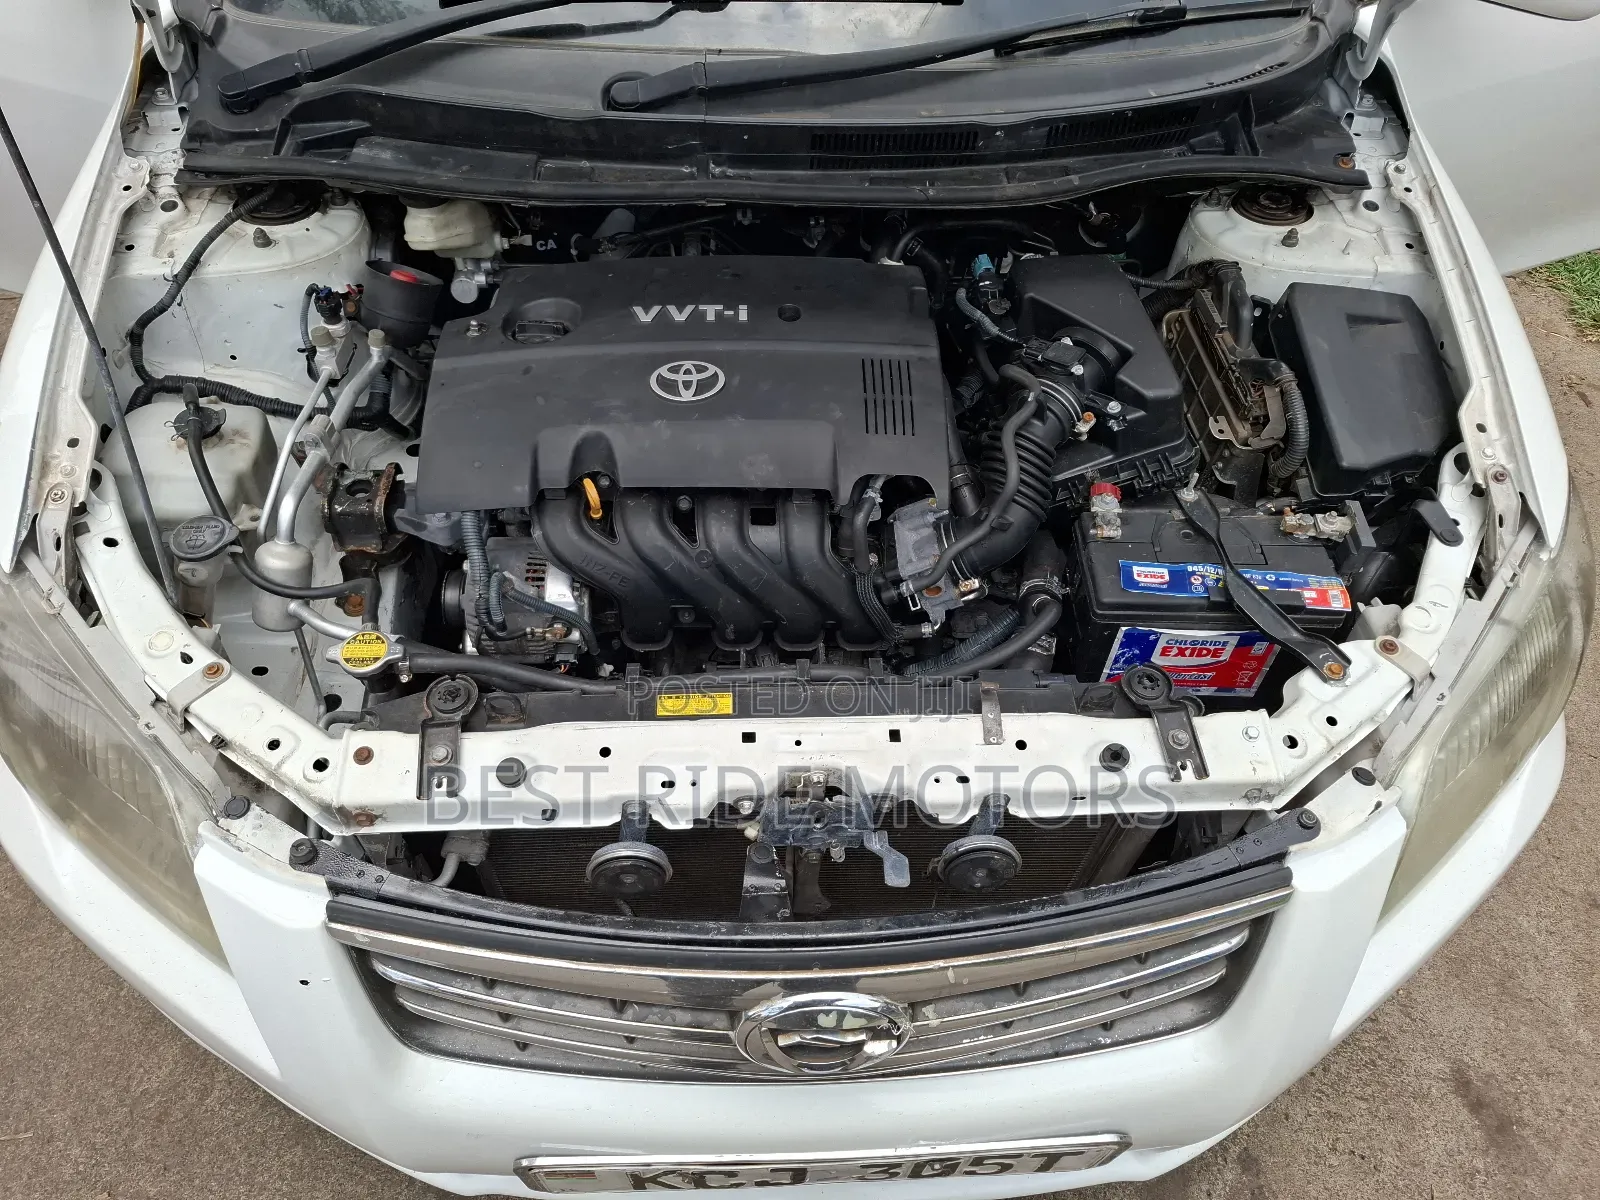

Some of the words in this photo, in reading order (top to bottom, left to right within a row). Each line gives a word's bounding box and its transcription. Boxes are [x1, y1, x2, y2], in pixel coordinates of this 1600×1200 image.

[632, 304, 748, 322] VVT-i
[1165, 638, 1230, 648] CHLORIDE
[1158, 646, 1228, 659] EXIDE
[626, 1167, 808, 1191] KCJ
